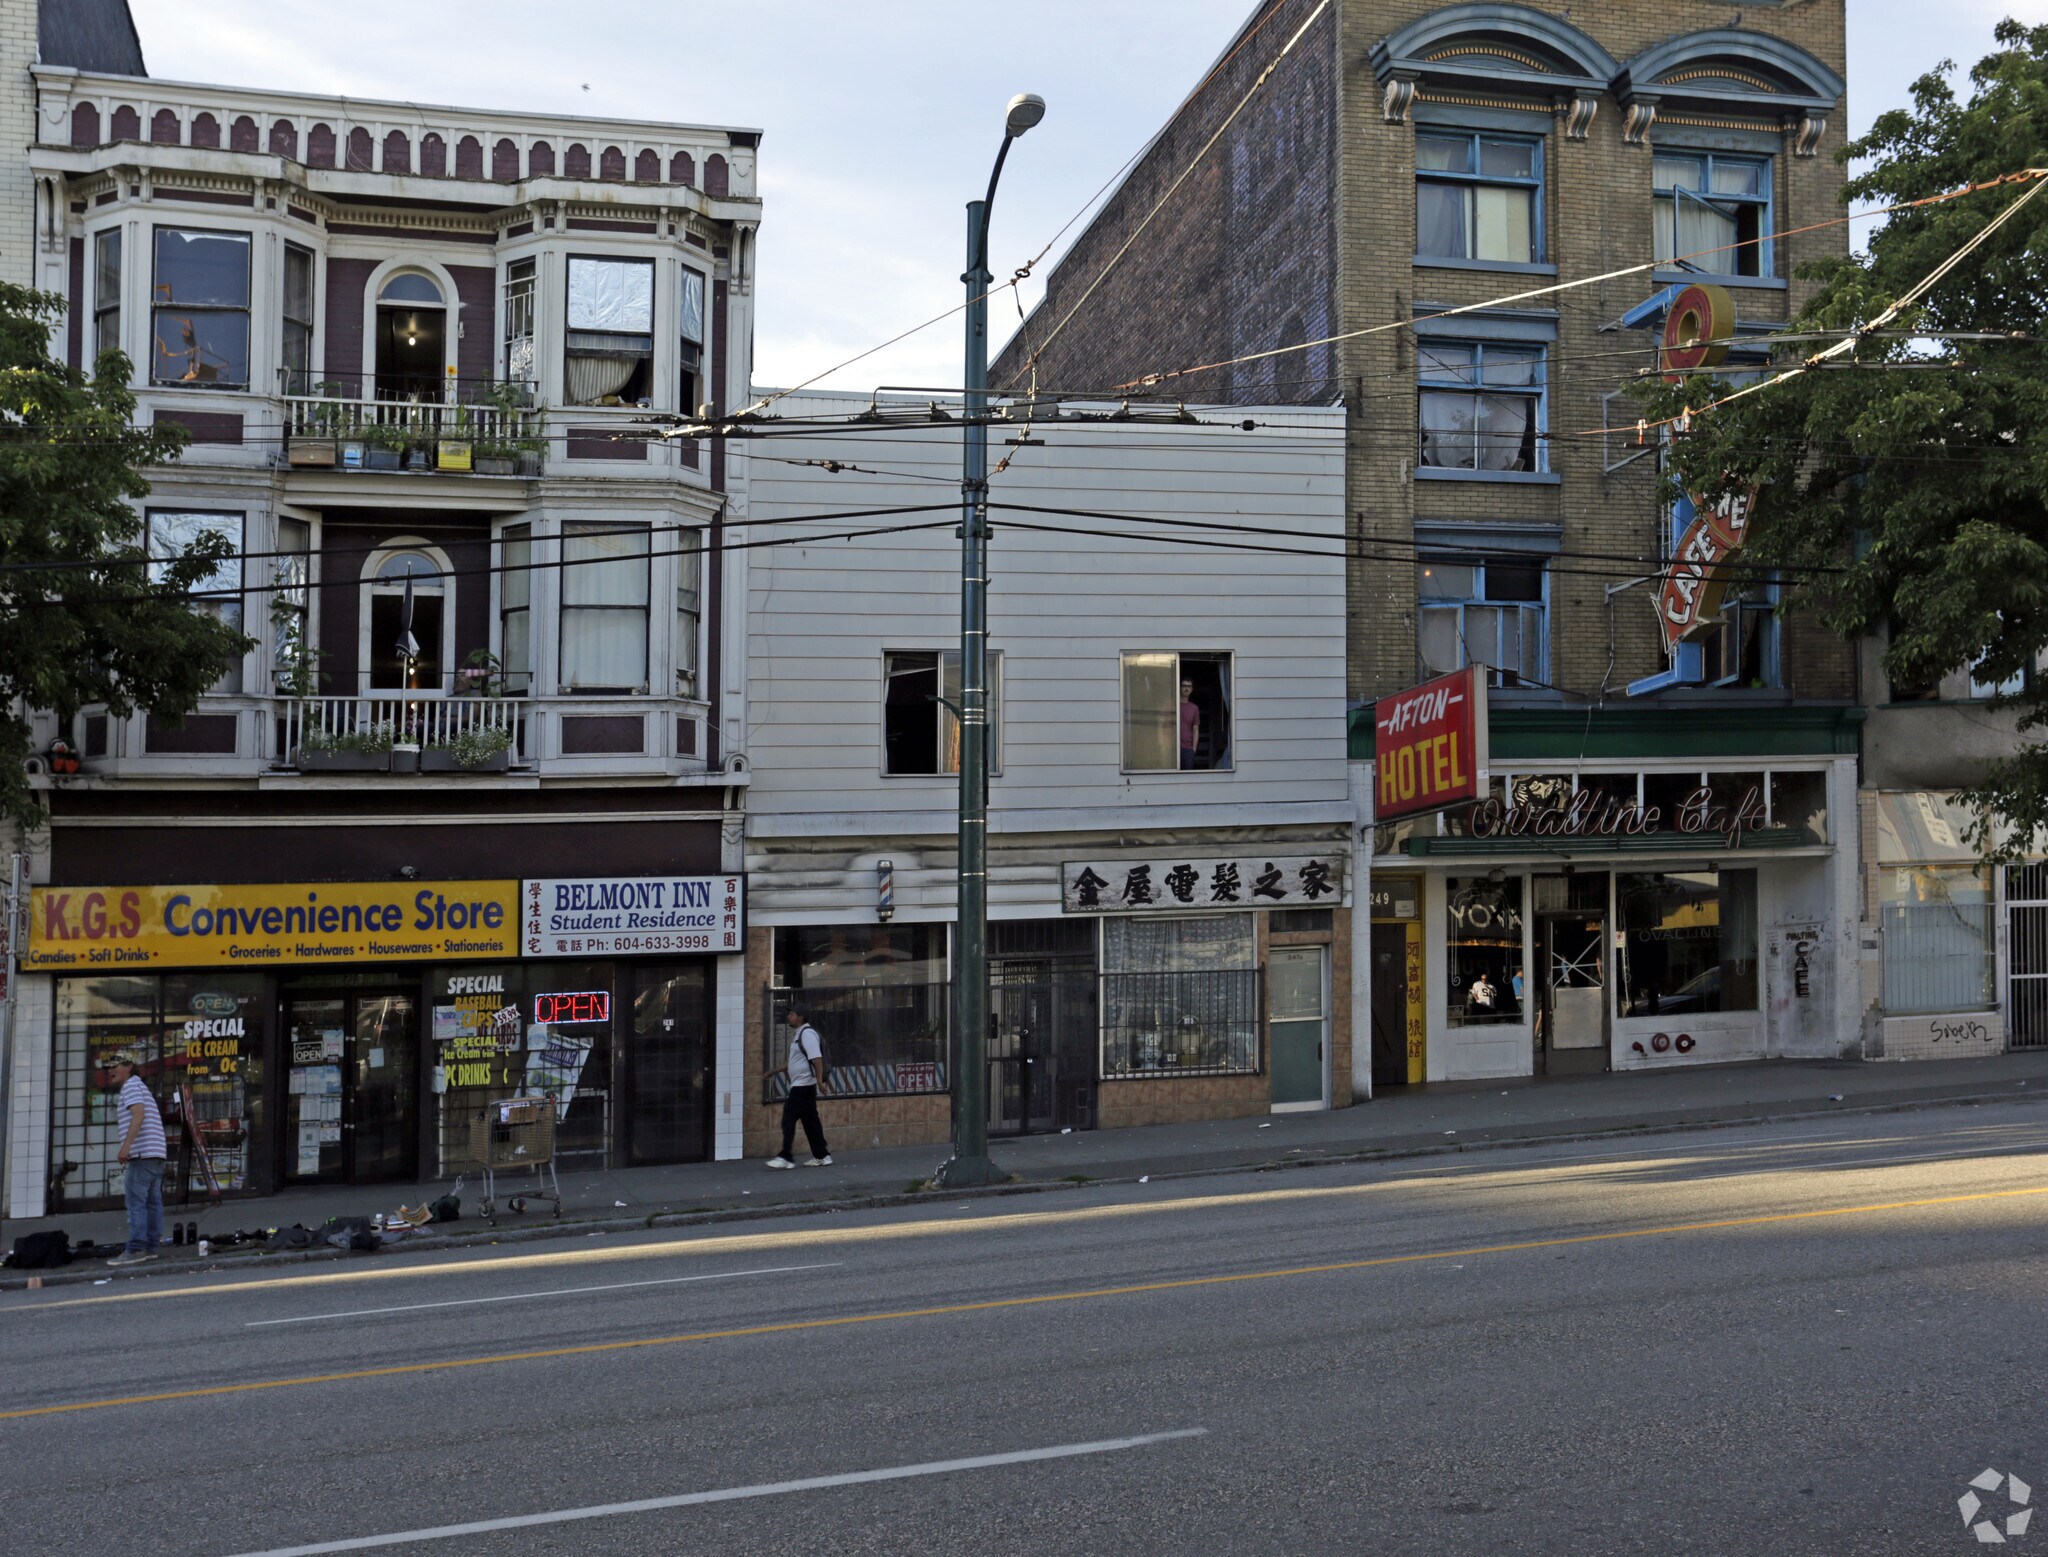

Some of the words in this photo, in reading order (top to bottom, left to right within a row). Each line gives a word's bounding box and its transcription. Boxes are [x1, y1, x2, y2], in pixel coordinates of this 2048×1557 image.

[1665, 523, 1716, 626] CAFE
[1380, 731, 1467, 806] HOTEL
[1471, 789, 1661, 839] Ovaltine
[1677, 785, 1768, 849] Cafe
[555, 882, 665, 911] BELMONT
[672, 881, 711, 908] INN
[1369, 892, 1389, 905] 249
[45, 891, 141, 941] K.G.S
[163, 892, 403, 936] Convenience
[414, 890, 504, 930] Store
[527, 882, 543, 954] 學生住宅
[550, 912, 622, 931] Student
[627, 911, 716, 929] Residence
[30, 949, 77, 964] Candies
[89, 947, 111, 962] Soft
[114, 946, 149, 962] Drinks
[229, 944, 281, 959] Groceries
[295, 943, 354, 957] Hardwares
[368, 941, 433, 955] Housewares
[444, 938, 504, 953] Stationeries
[556, 939, 582, 952] 電話
[587, 938, 609, 951] Ph:
[614, 935, 709, 951] 604-633-3998
[447, 975, 505, 995] SPECIAL
[194, 997, 234, 1010] OPEN
[454, 994, 502, 1011] BASEBALL
[537, 993, 607, 1023] OPEN
[462, 1009, 493, 1029] CAPS
[497, 1007, 517, 1025] $9.99
[184, 1018, 246, 1039] SPECIAL
[186, 1041, 201, 1058] ICE
[204, 1039, 238, 1058] CREAM
[453, 1036, 498, 1048] SPECIAL
[296, 1050, 321, 1060] OPEN
[444, 1049, 455, 1061] Ice
[456, 1047, 481, 1059] Cream
[482, 1050, 495, 1058] from
[187, 1063, 208, 1075] from
[445, 1065, 457, 1087] PC
[458, 1063, 491, 1086] DRINKS
[898, 1073, 933, 1088] OPEN
